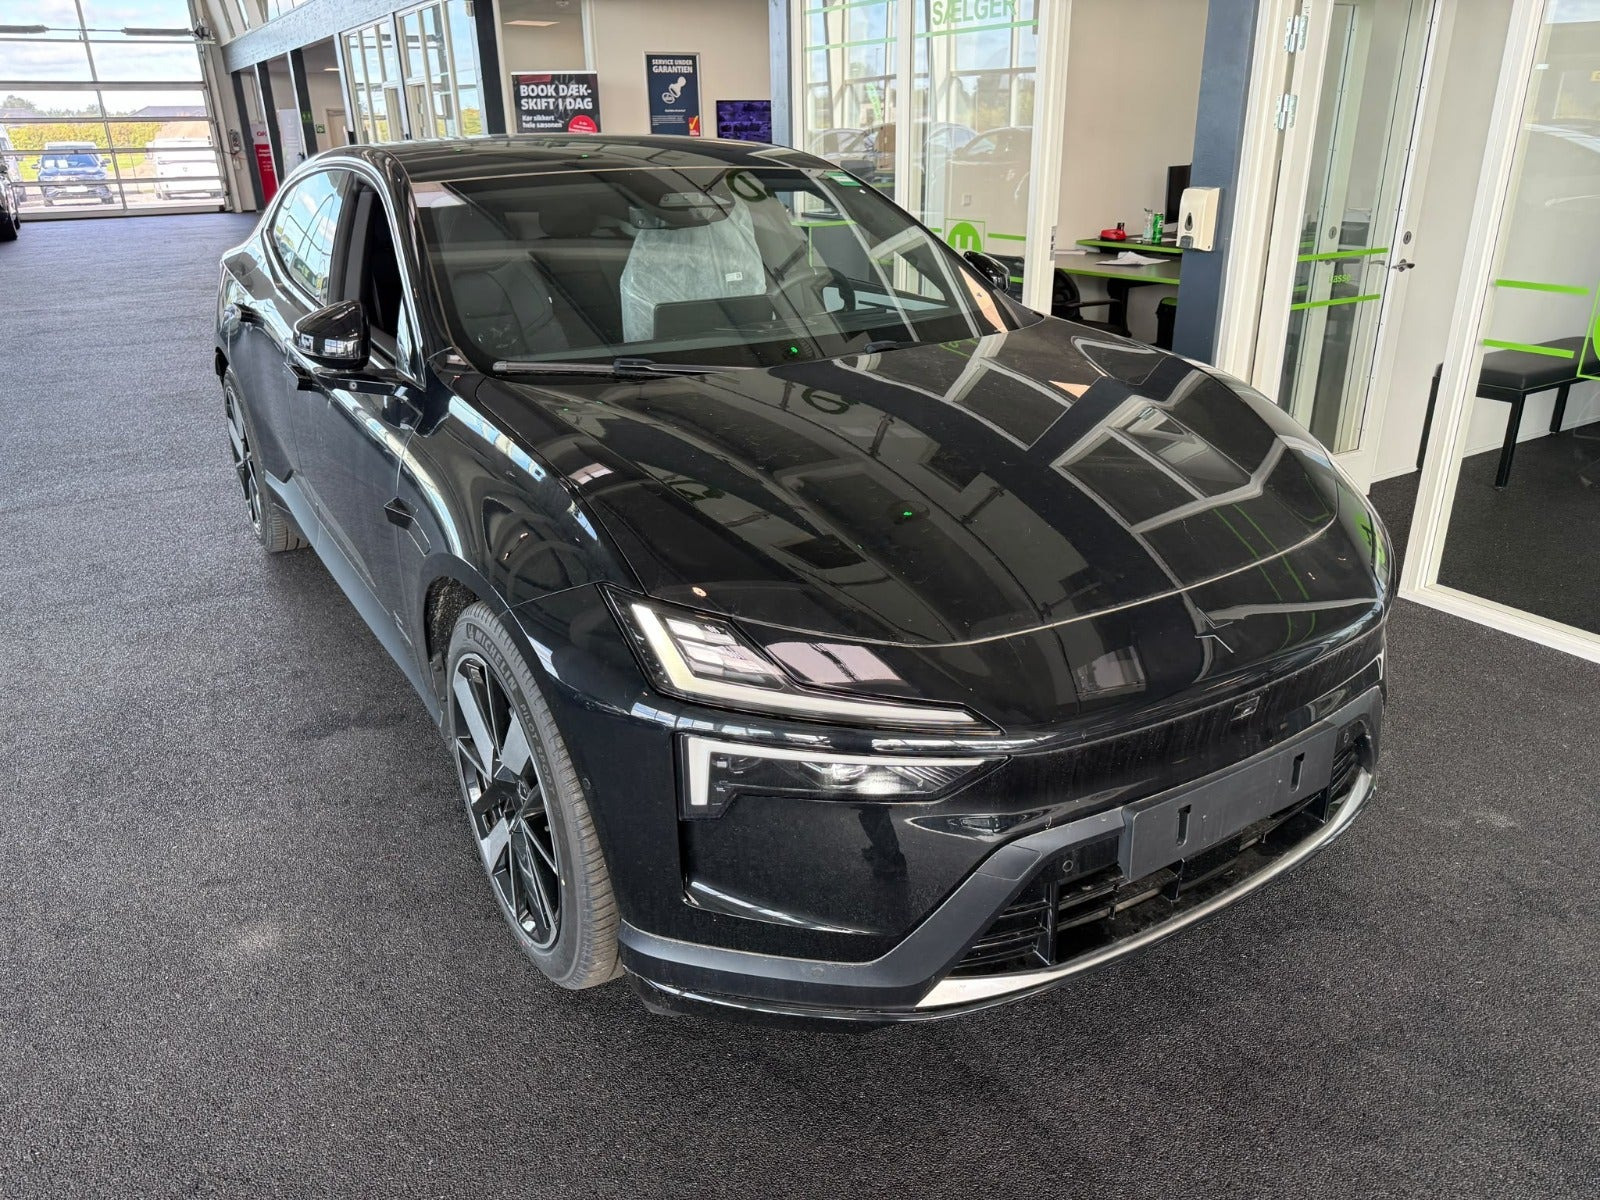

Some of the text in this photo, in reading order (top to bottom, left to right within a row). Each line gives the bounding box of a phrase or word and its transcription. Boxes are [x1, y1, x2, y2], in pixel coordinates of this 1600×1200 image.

[932, 0, 1016, 25] SÆLGER
[652, 65, 693, 73] GARANTIEN
[520, 84, 592, 96] BOOK DÆK-
[521, 98, 555, 110] SKIFT
[566, 98, 593, 109] DAG
[474, 629, 517, 691] MICHELIN
[520, 703, 556, 796] PILOT SPORT
